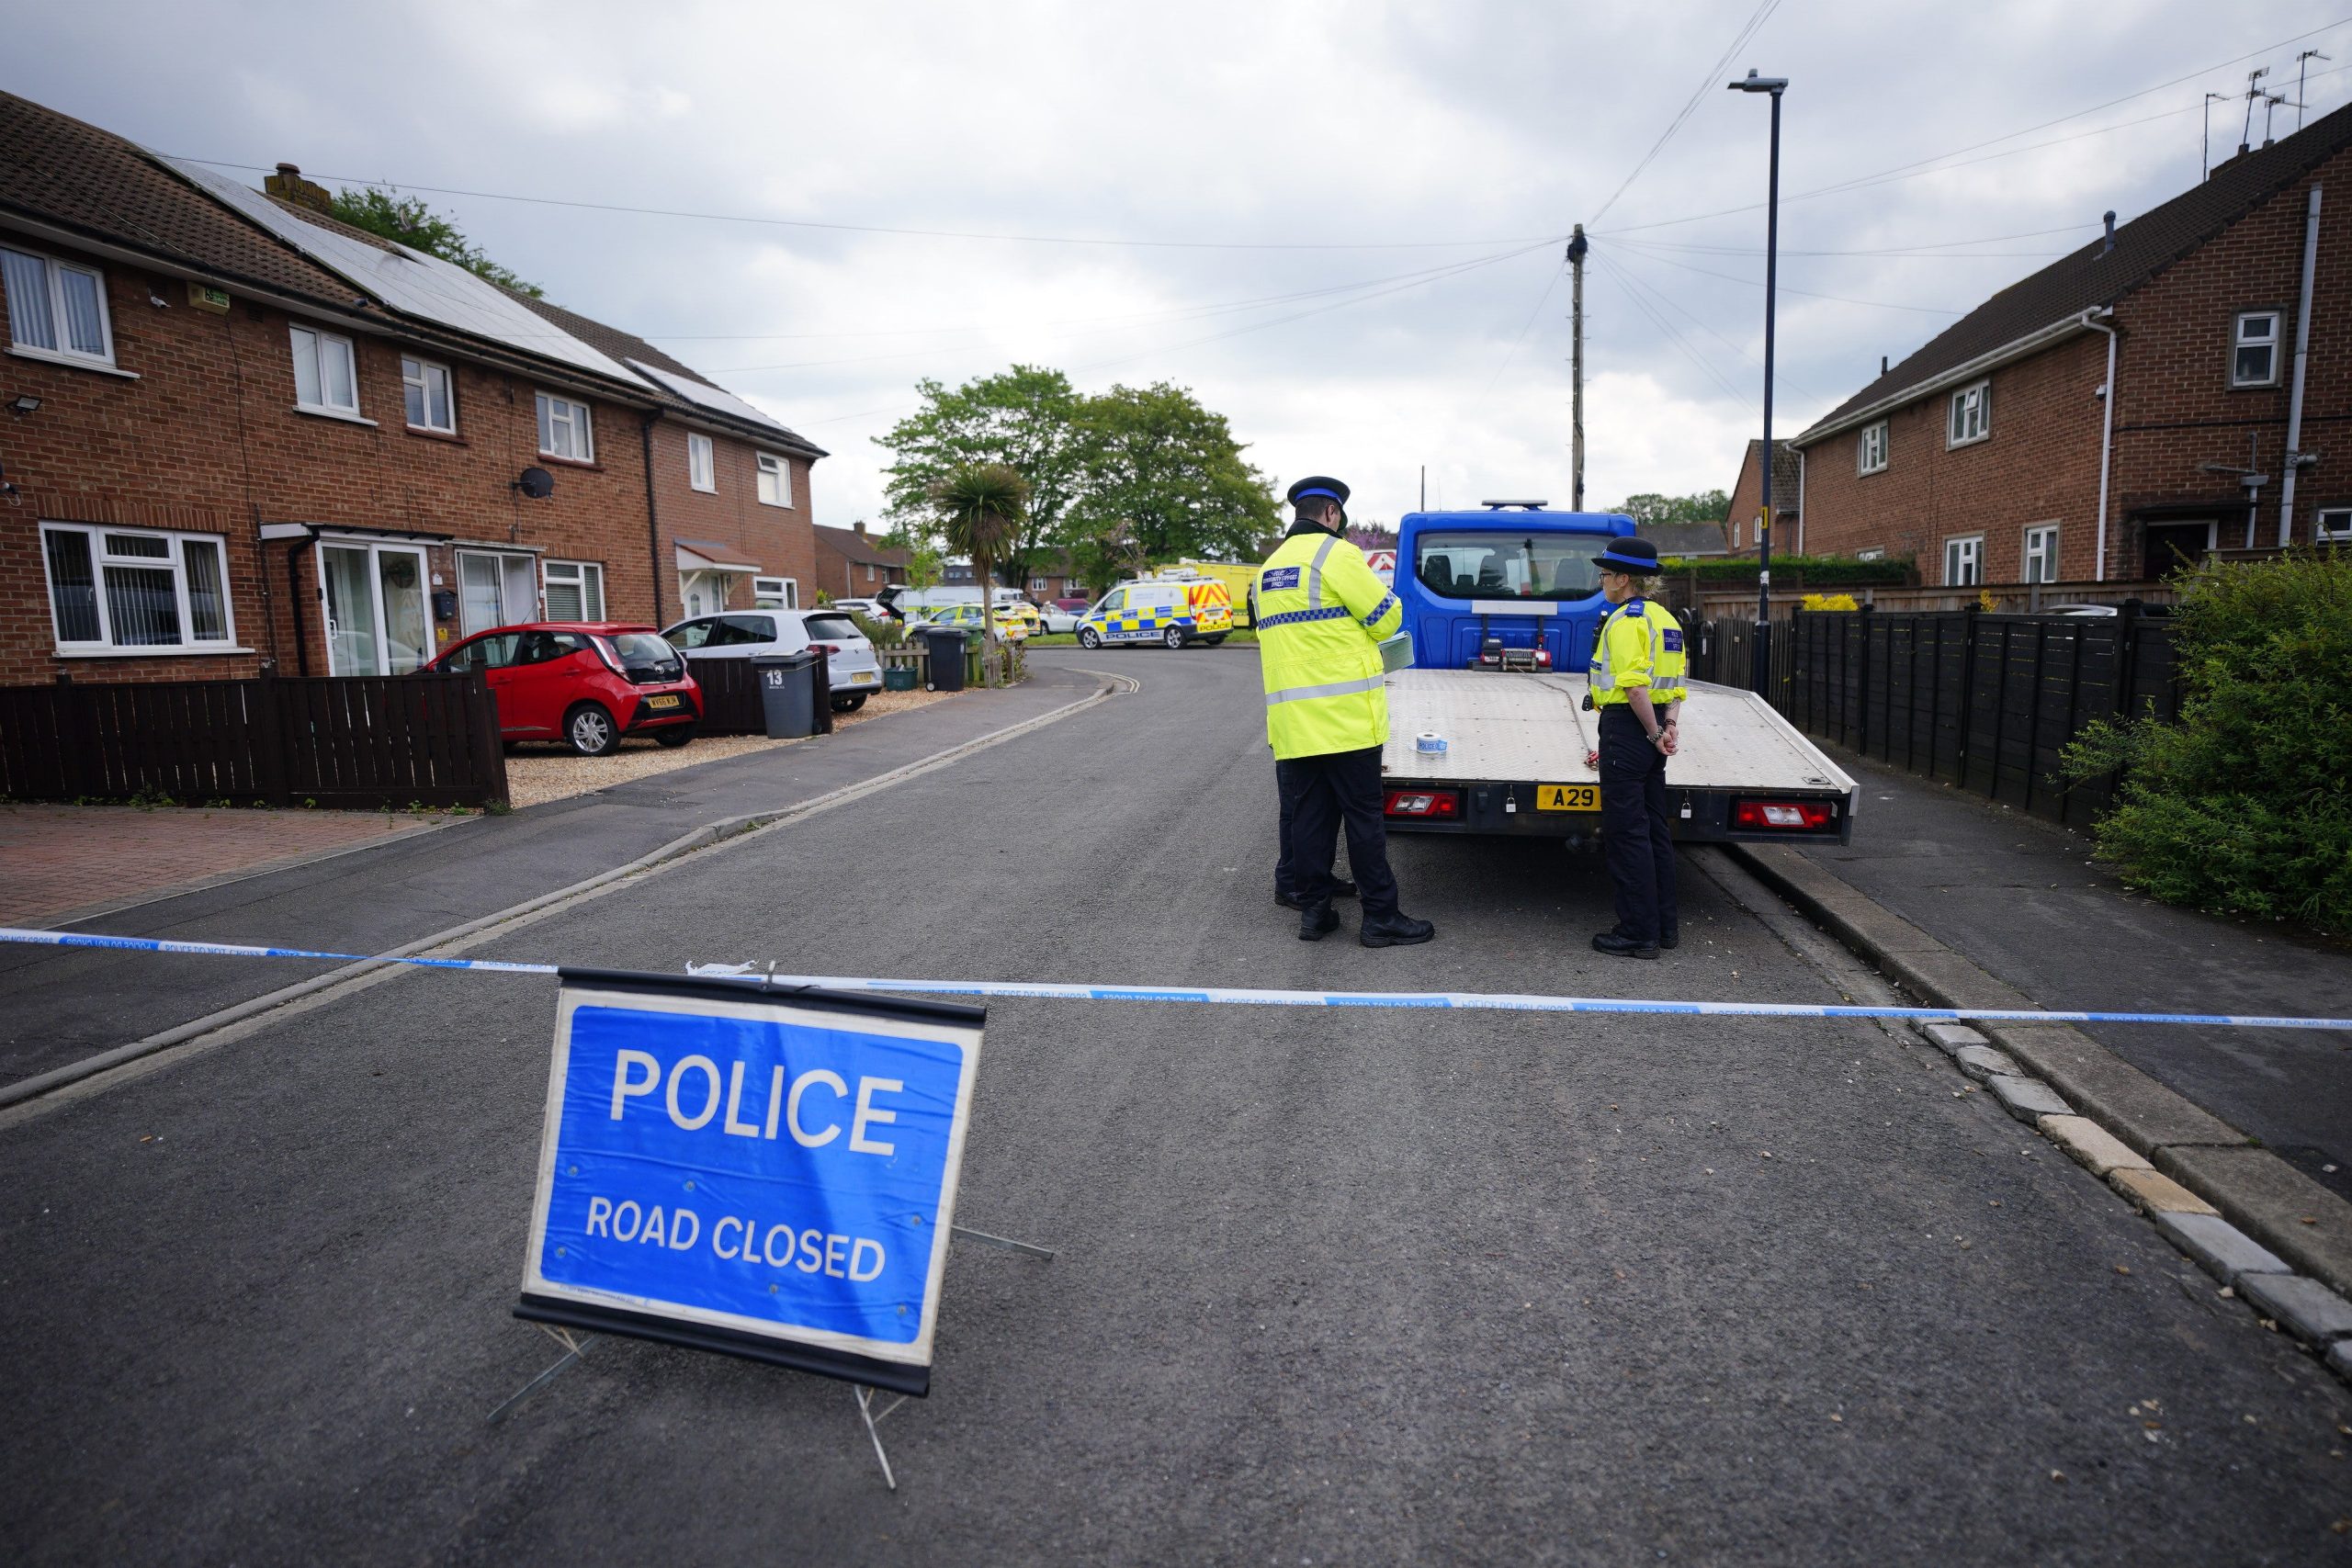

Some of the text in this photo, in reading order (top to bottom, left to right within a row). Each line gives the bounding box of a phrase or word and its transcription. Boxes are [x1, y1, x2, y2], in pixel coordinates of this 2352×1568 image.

[1106, 631, 1160, 639] POLICE
[1200, 623, 1230, 631] POLICE
[767, 670, 782, 685] 13
[1553, 788, 1594, 807] A29
[610, 1048, 904, 1156] POLICE
[585, 1197, 886, 1282] ROAD CLOSED
